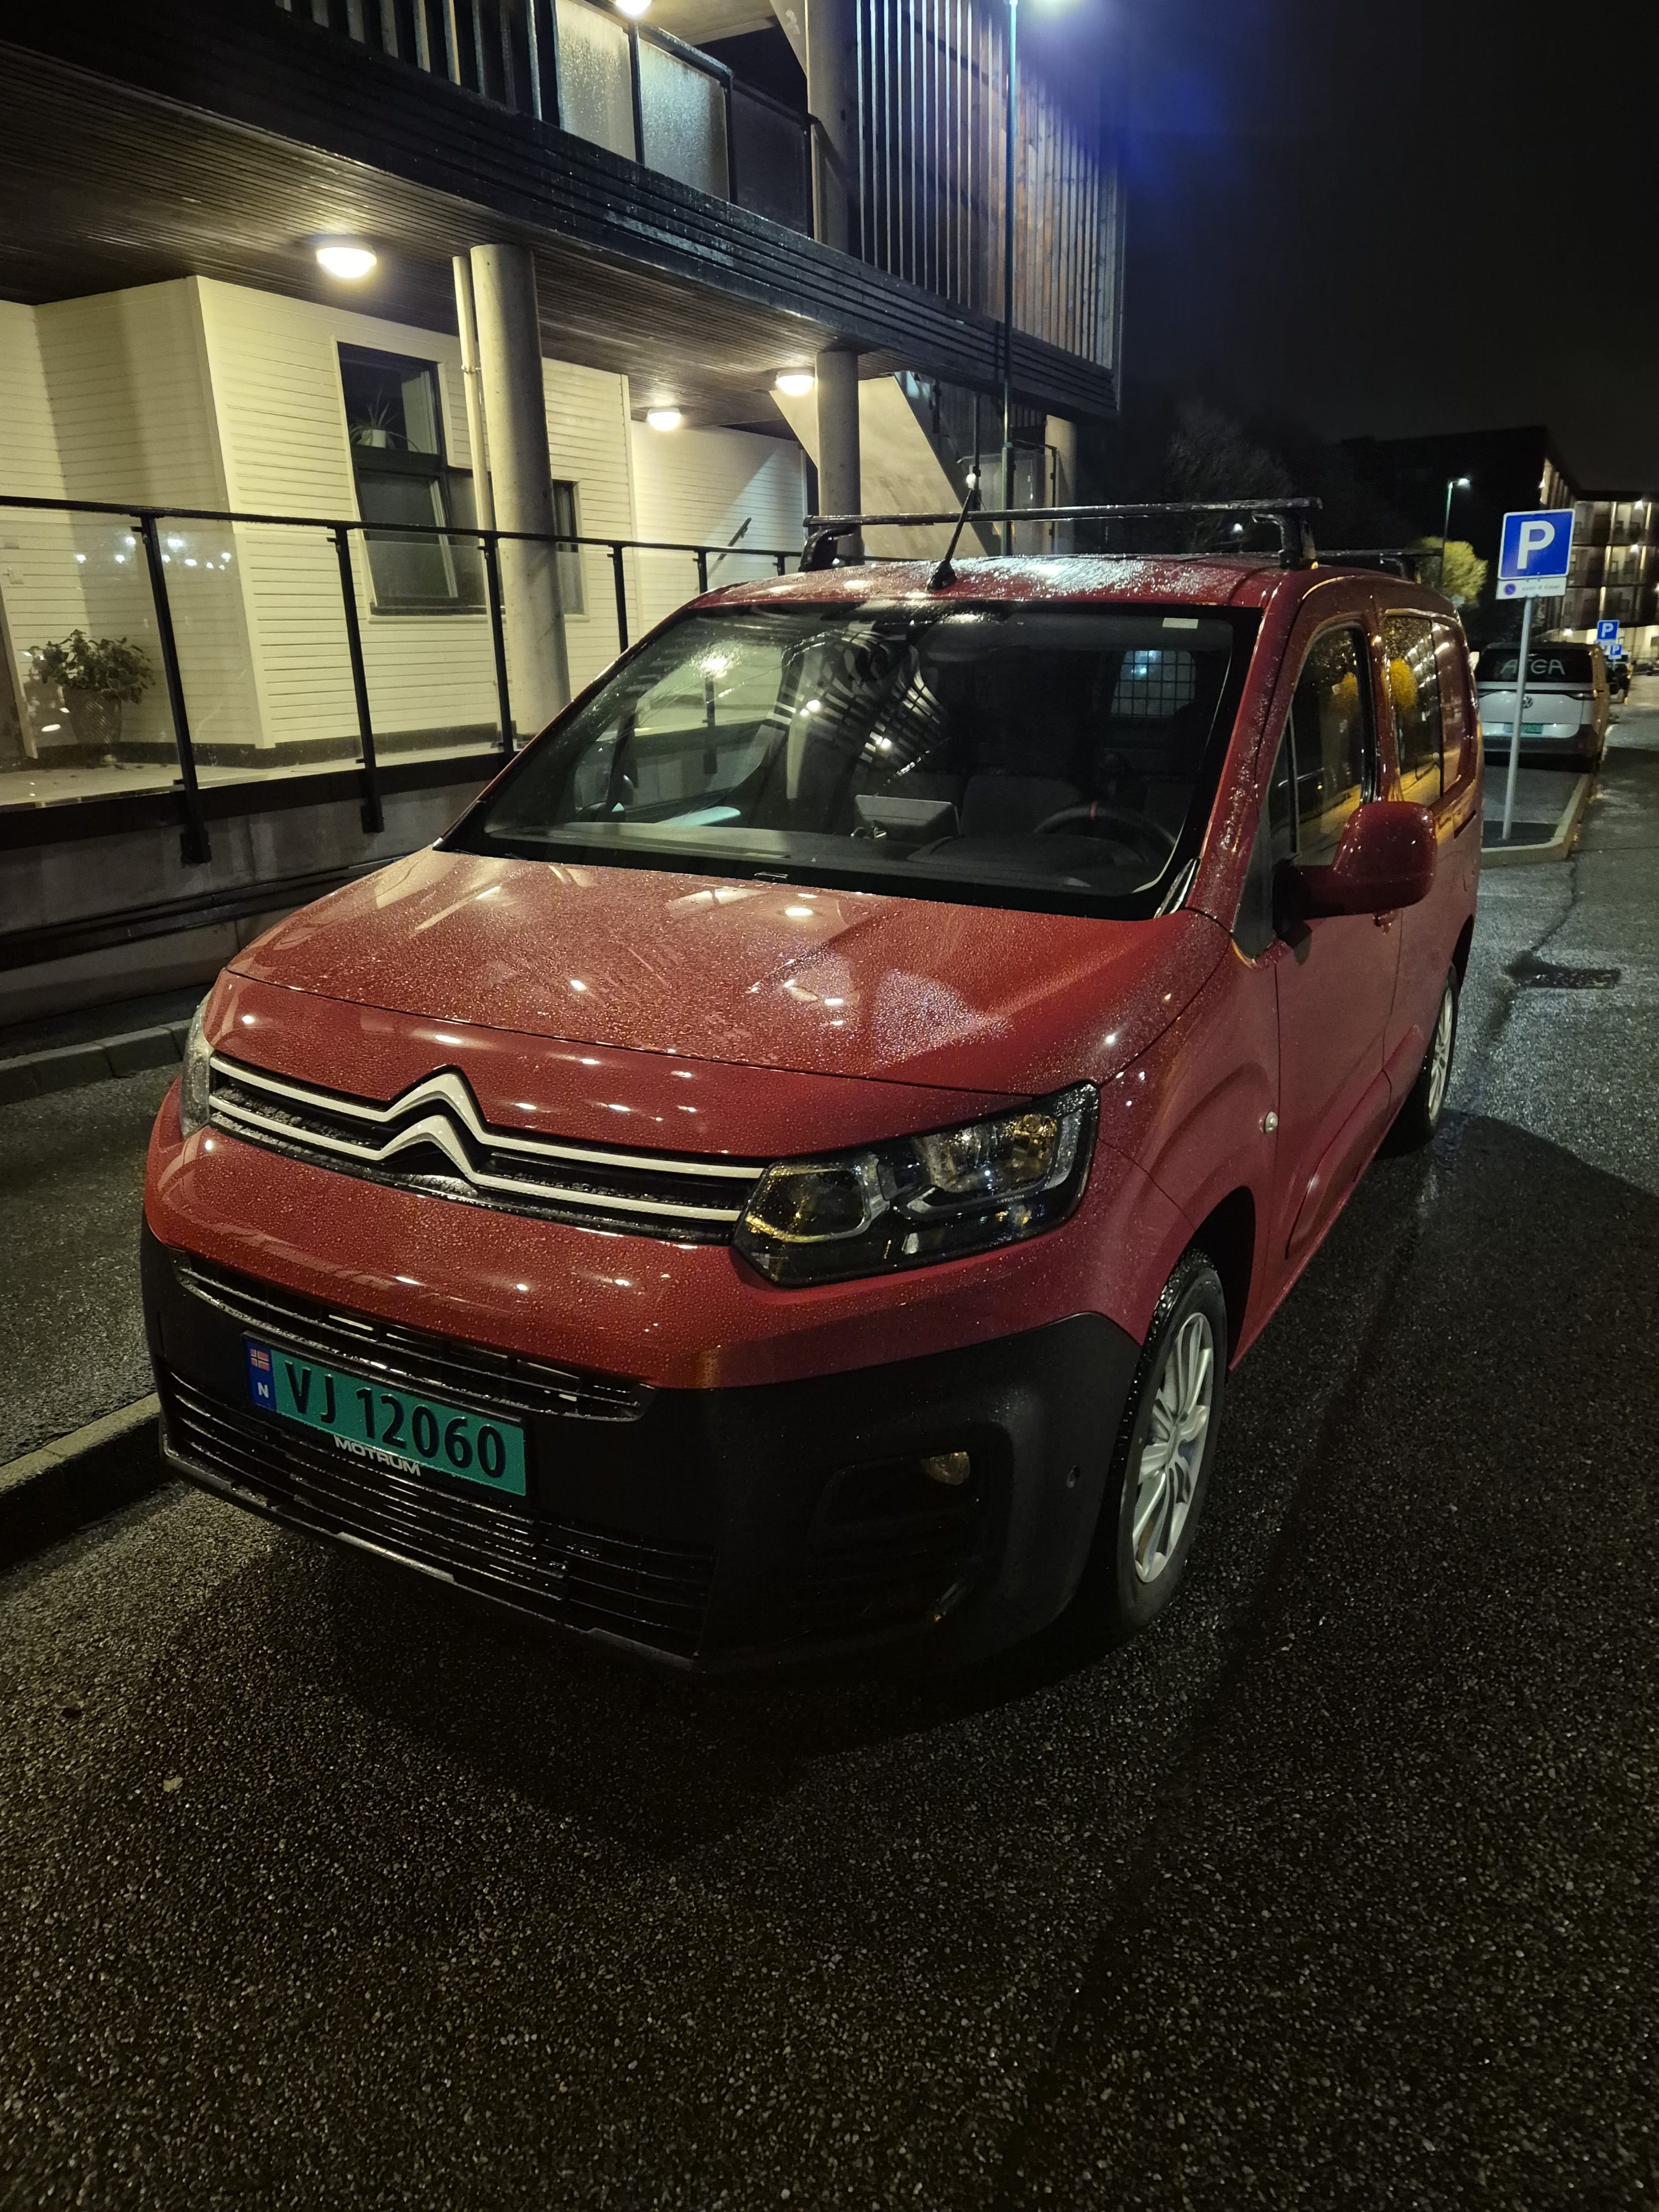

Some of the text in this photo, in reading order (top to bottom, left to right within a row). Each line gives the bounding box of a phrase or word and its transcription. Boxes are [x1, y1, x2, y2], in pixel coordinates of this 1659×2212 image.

[1517, 520, 1554, 569] P
[1601, 623, 1614, 638] P
[1612, 645, 1620, 654] P
[1499, 659, 1566, 675] AEA
[257, 1381, 269, 1399] N
[285, 1360, 505, 1479] VJ 12060
[333, 1435, 421, 1477] MOTRUM
